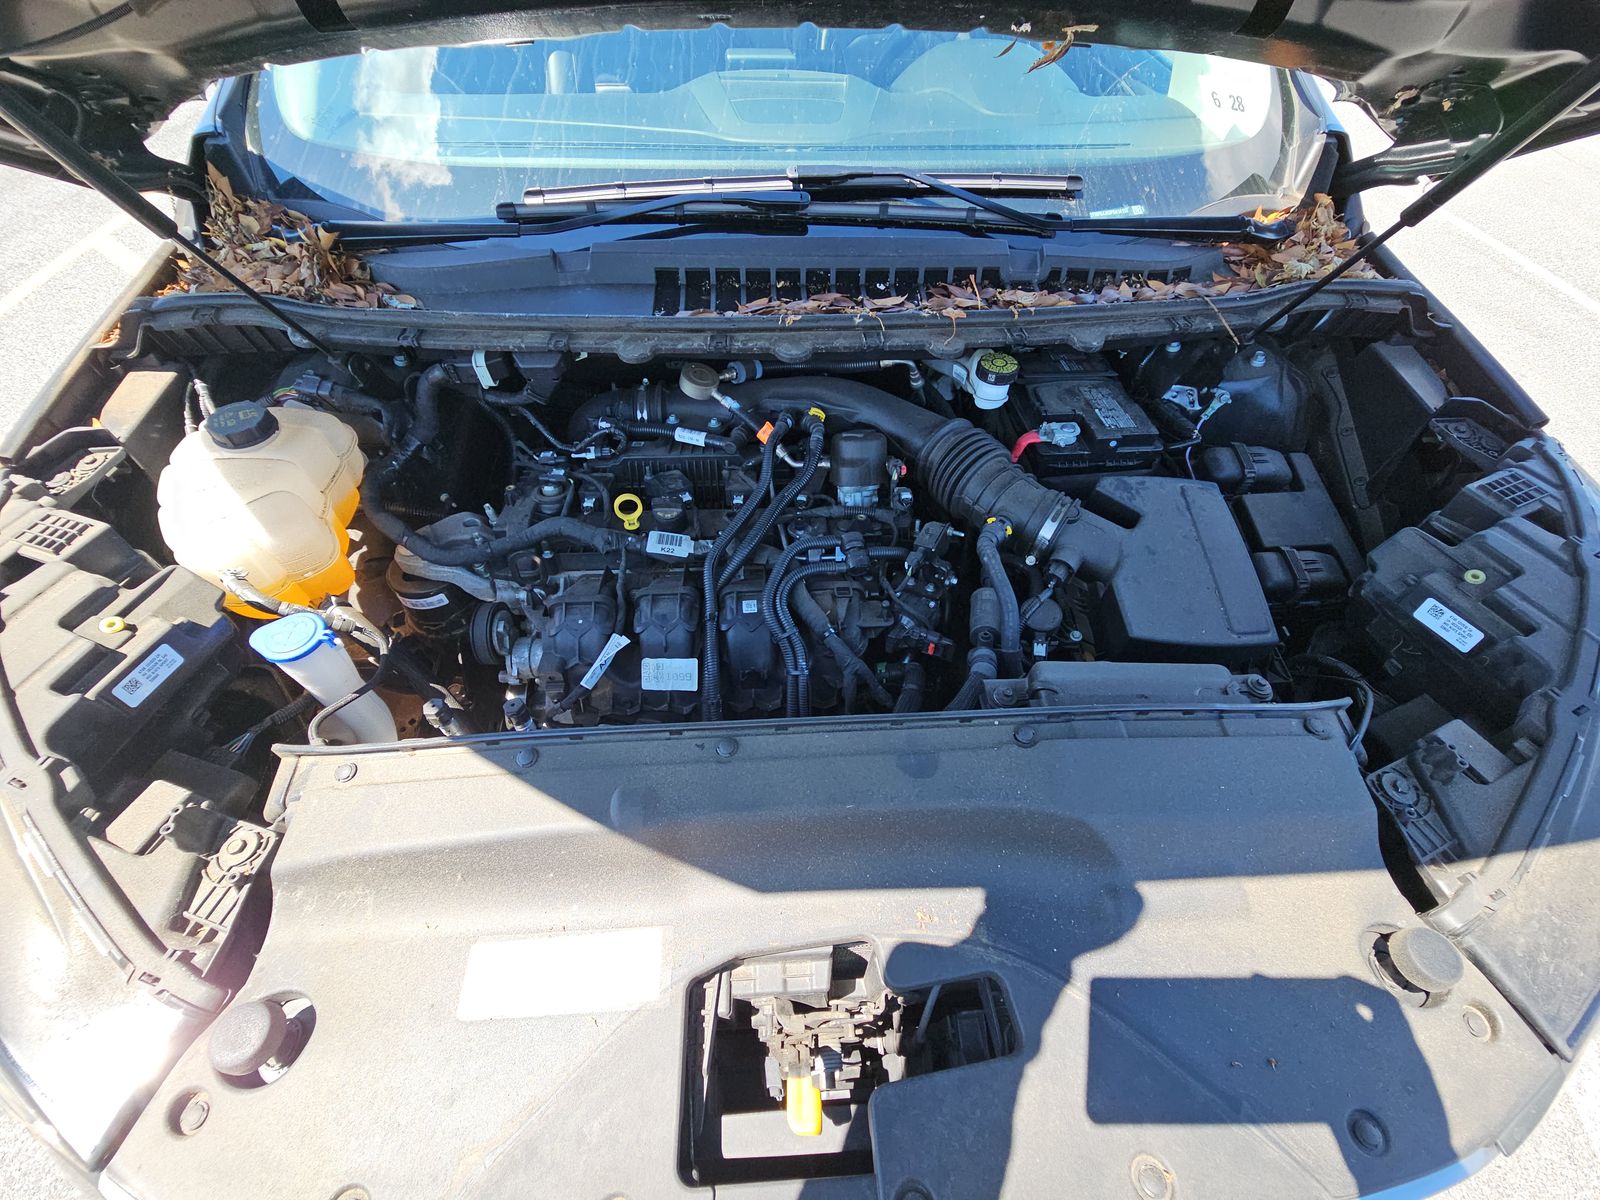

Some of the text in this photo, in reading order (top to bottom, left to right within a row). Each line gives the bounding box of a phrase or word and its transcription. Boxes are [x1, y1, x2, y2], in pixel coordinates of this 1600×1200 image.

[1211, 91, 1245, 112] 6 28
[660, 546, 675, 554] K22
